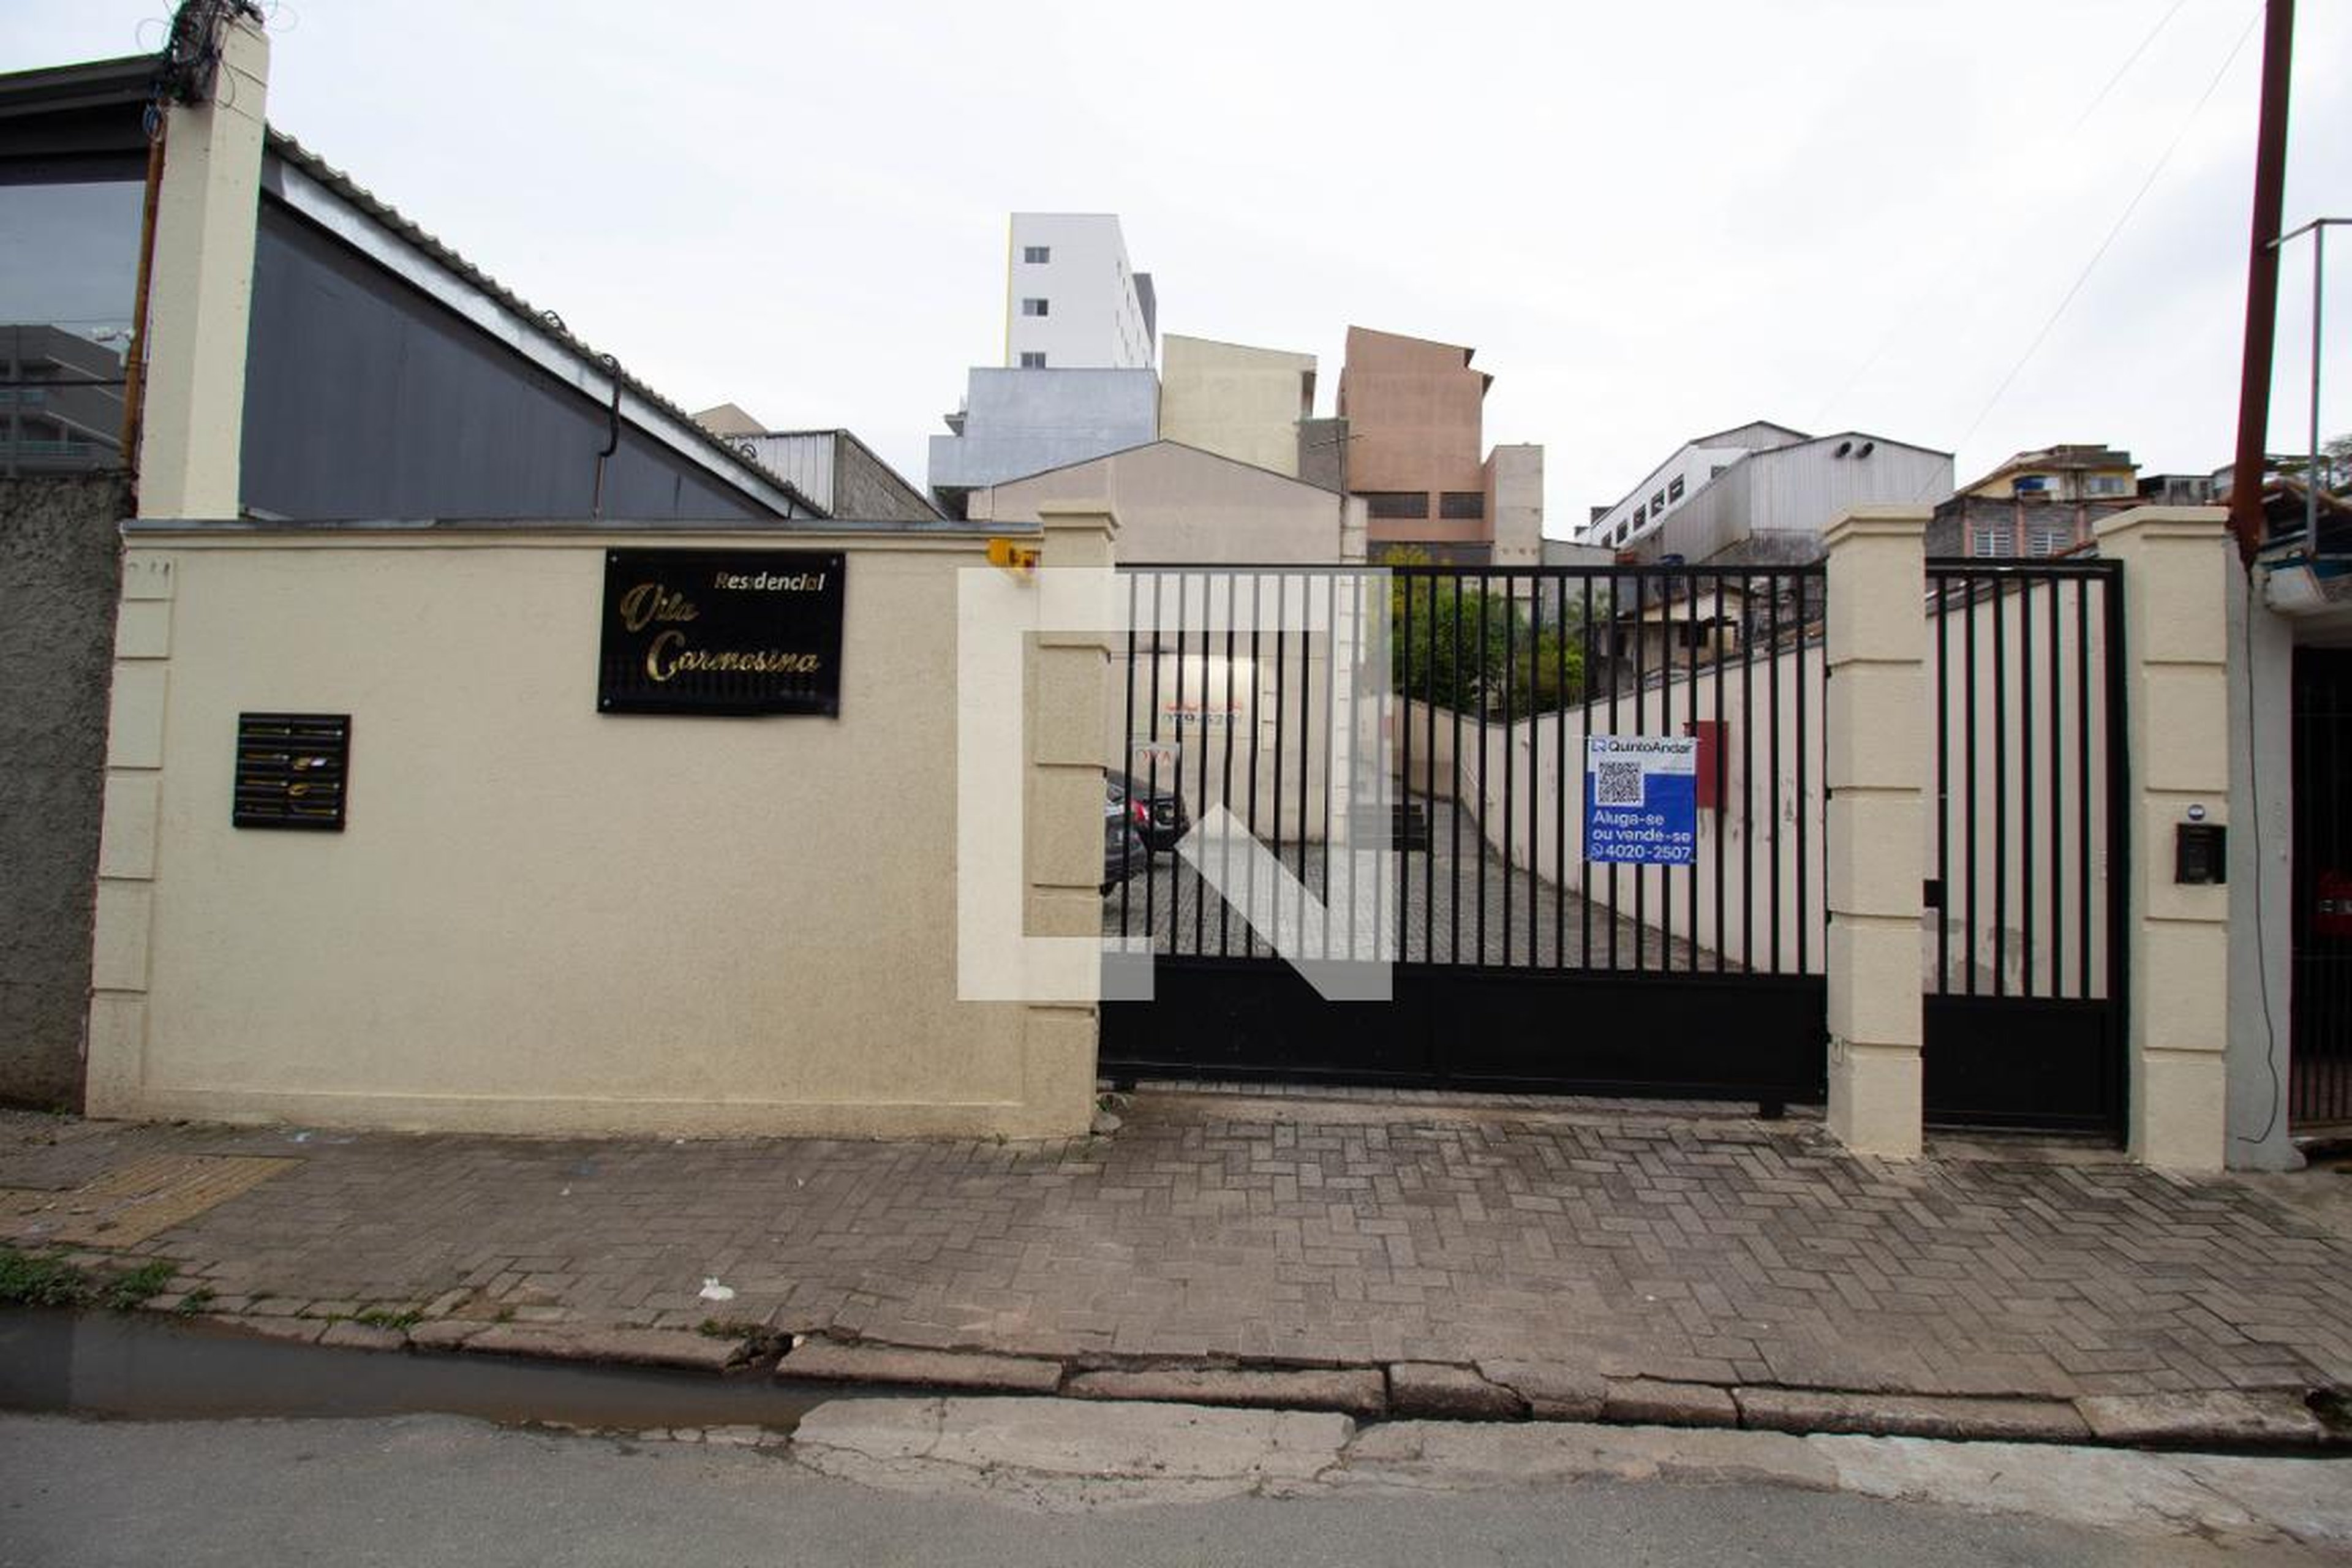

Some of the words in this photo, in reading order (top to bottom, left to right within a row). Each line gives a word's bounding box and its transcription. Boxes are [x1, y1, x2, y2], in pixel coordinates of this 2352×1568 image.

[714, 571, 827, 592] Residencial
[619, 581, 699, 633] Vila
[646, 630, 821, 682] Carmosina
[1608, 740, 1692, 754] QuintoAndar
[1593, 810, 1665, 827] Aluga-se
[1592, 830, 1613, 841] ou
[1616, 829, 1692, 843] vende-se
[1605, 845, 1692, 860] 4020-2507
